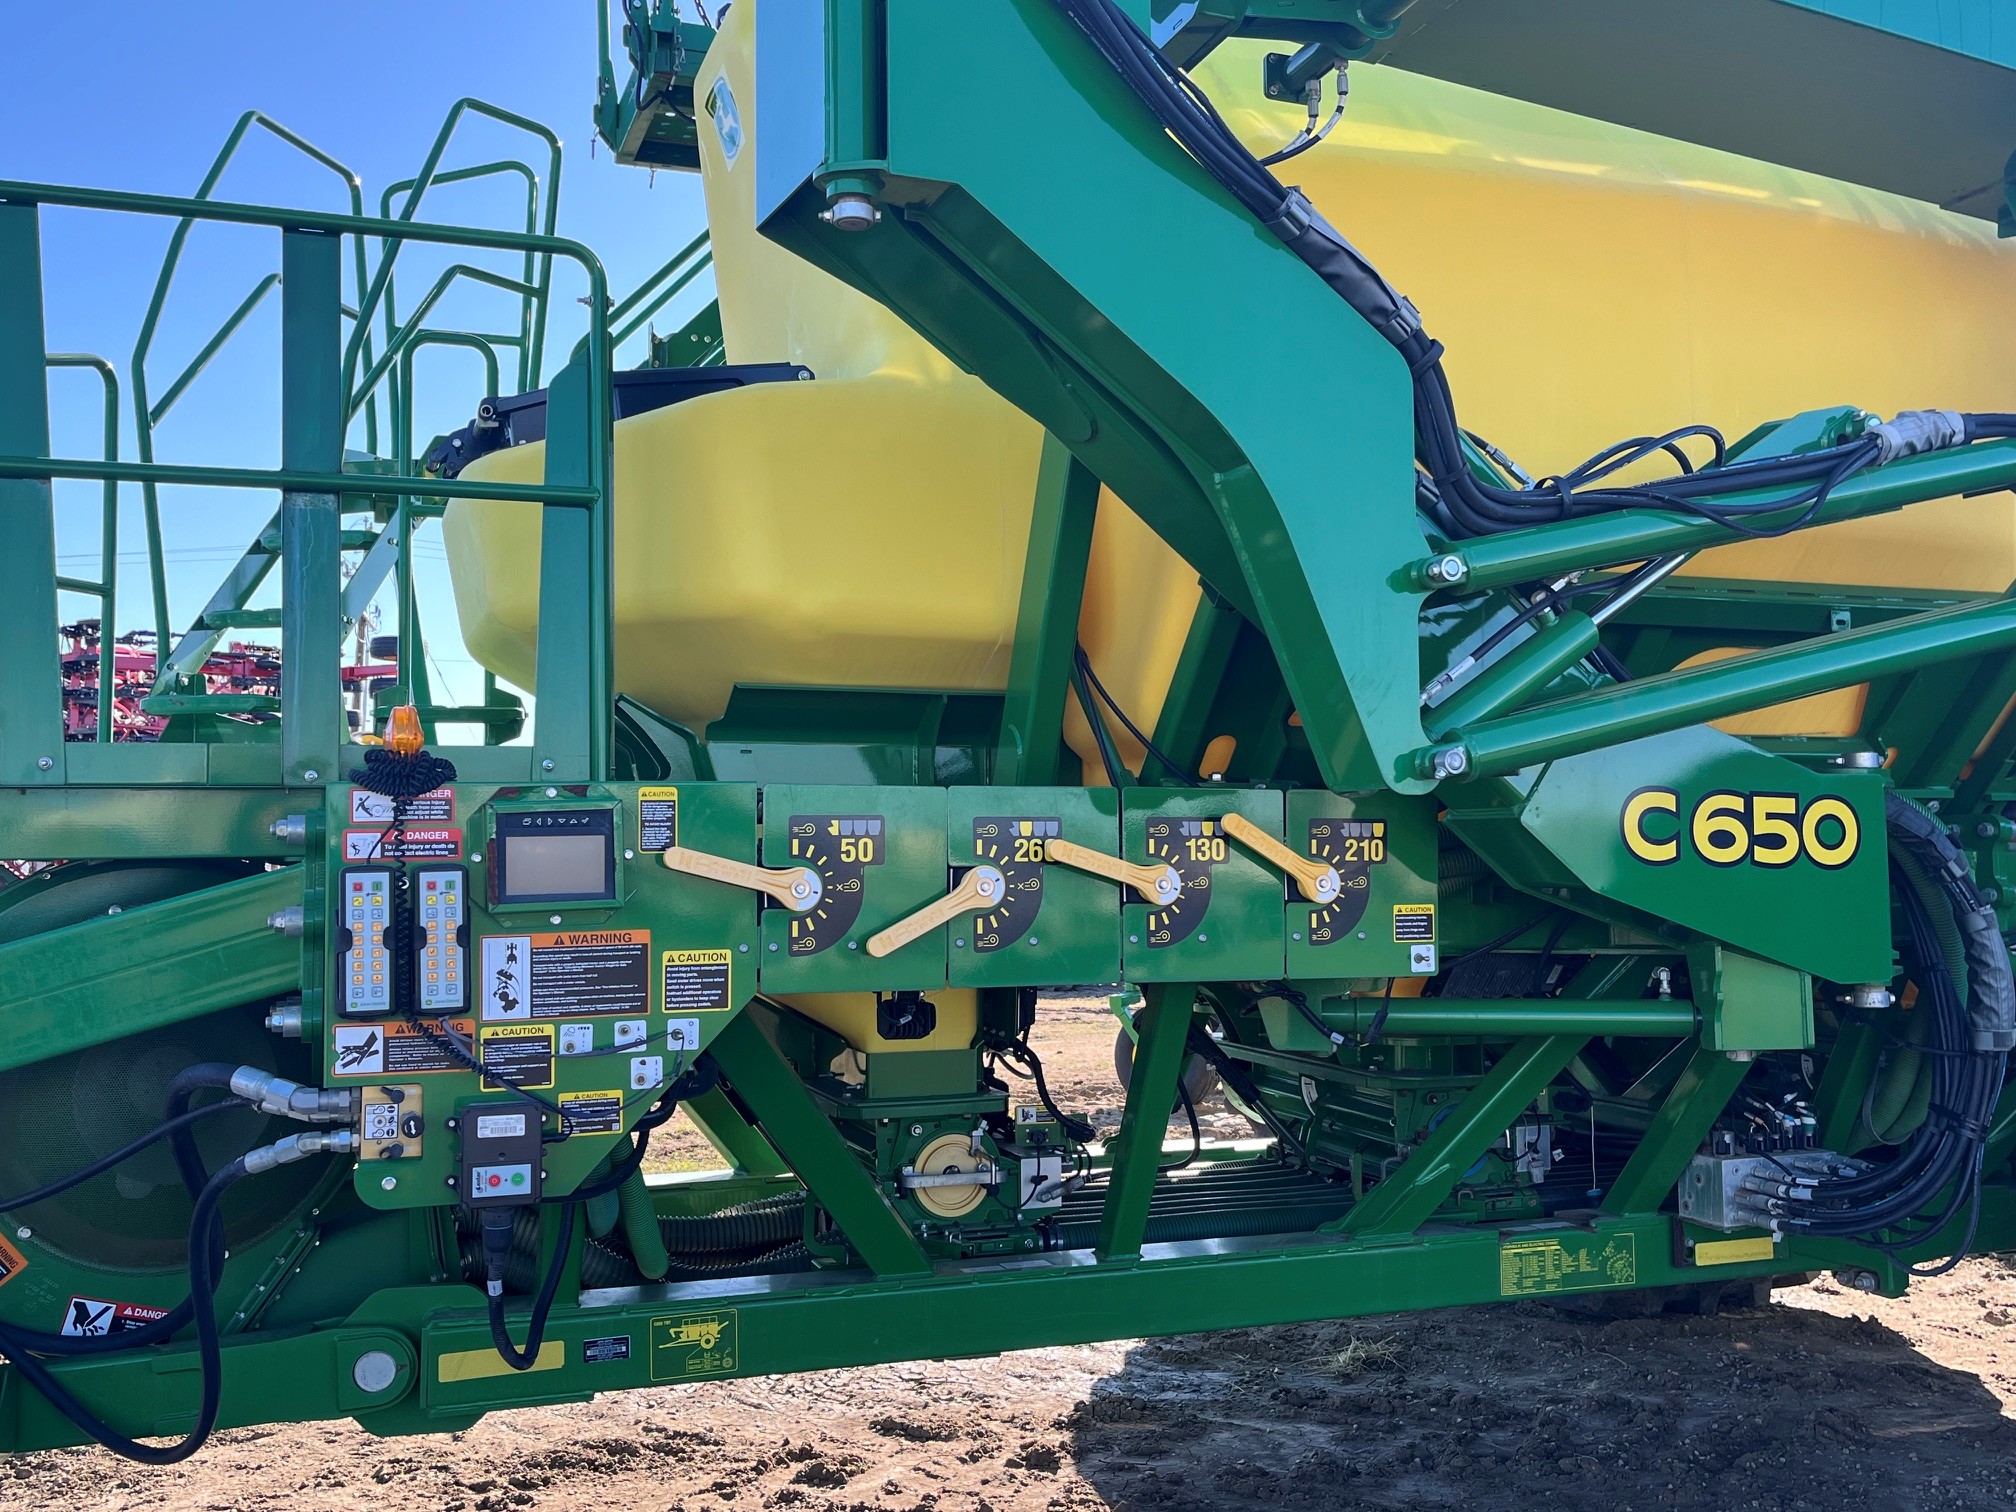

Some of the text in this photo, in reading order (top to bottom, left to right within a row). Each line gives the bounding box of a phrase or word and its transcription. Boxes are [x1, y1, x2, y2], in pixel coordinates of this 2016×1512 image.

[1620, 786, 1861, 870] C 650
[406, 832, 448, 840] DANGER
[840, 838, 874, 862] 50
[1186, 838, 1226, 861] 130
[1344, 838, 1384, 862] 210
[569, 932, 632, 945] WARNING
[678, 953, 727, 962] CAUTION
[406, 1023, 464, 1034] WRNING
[502, 1027, 544, 1036] CAUTION
